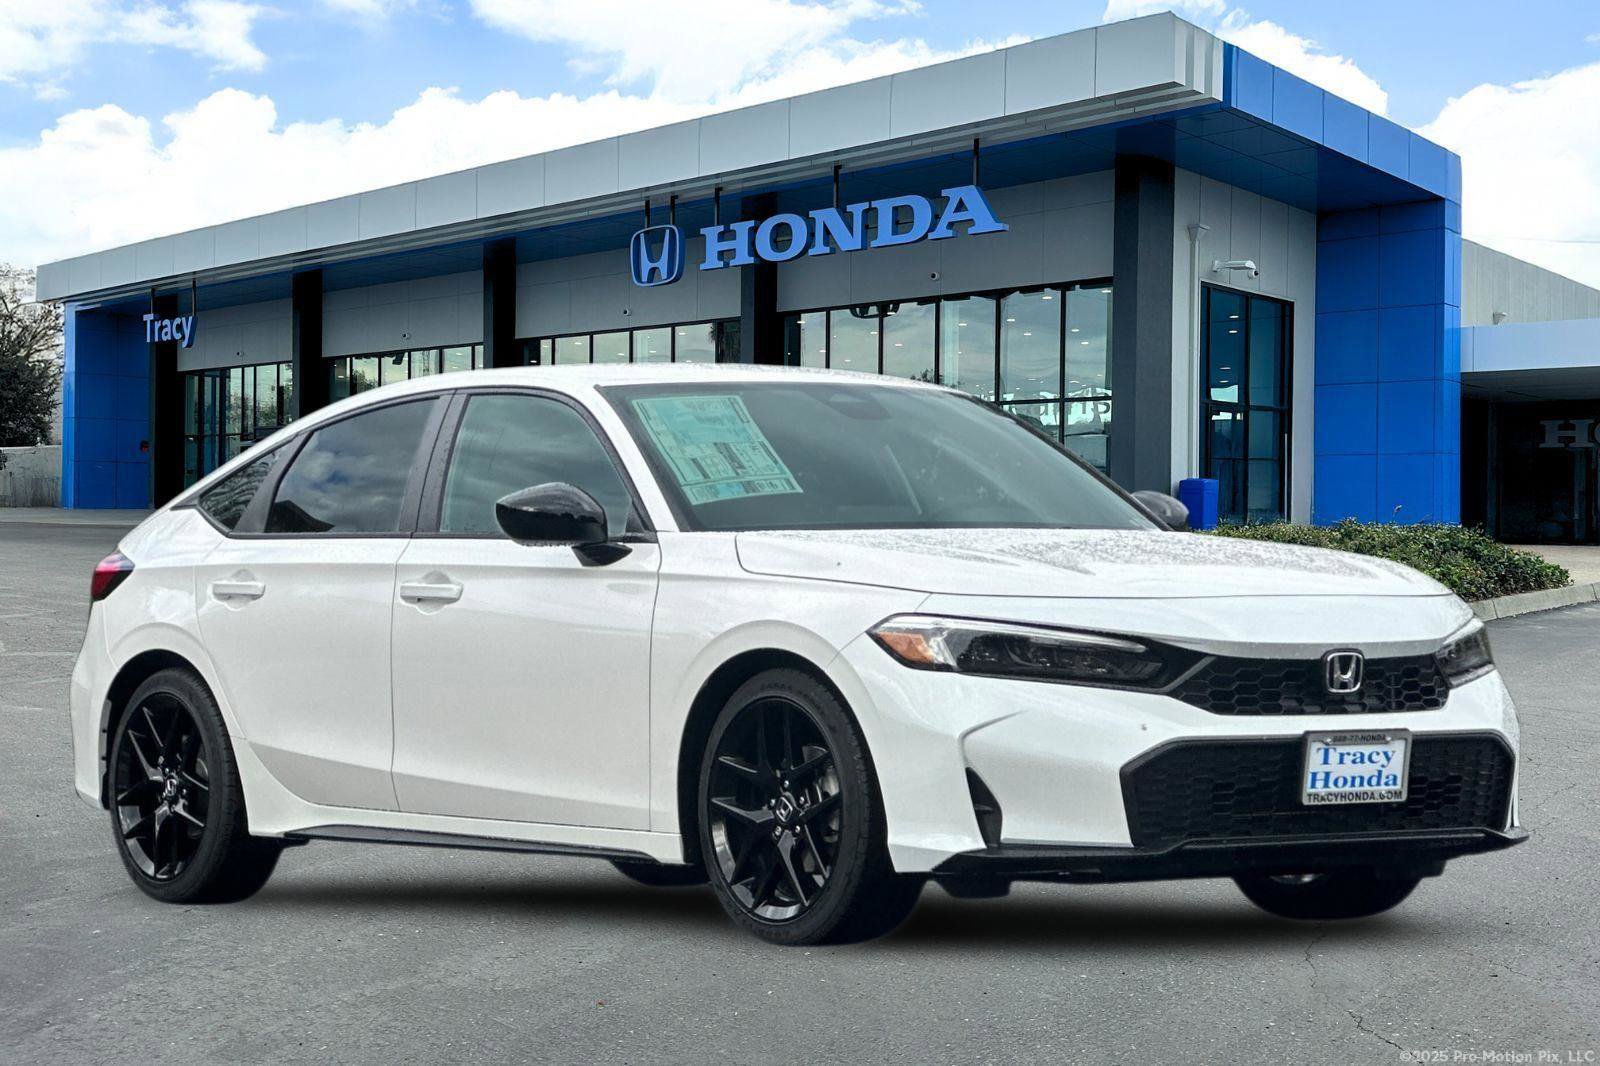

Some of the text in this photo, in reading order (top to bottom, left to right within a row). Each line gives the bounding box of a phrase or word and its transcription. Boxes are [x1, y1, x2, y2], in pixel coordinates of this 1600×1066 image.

[699, 184, 1008, 271] HONDA
[143, 313, 195, 348] Tracy
[1316, 747, 1396, 769] Tracy
[1309, 769, 1398, 789] Honda
[1307, 791, 1402, 803] TRACYHONDA.COM
